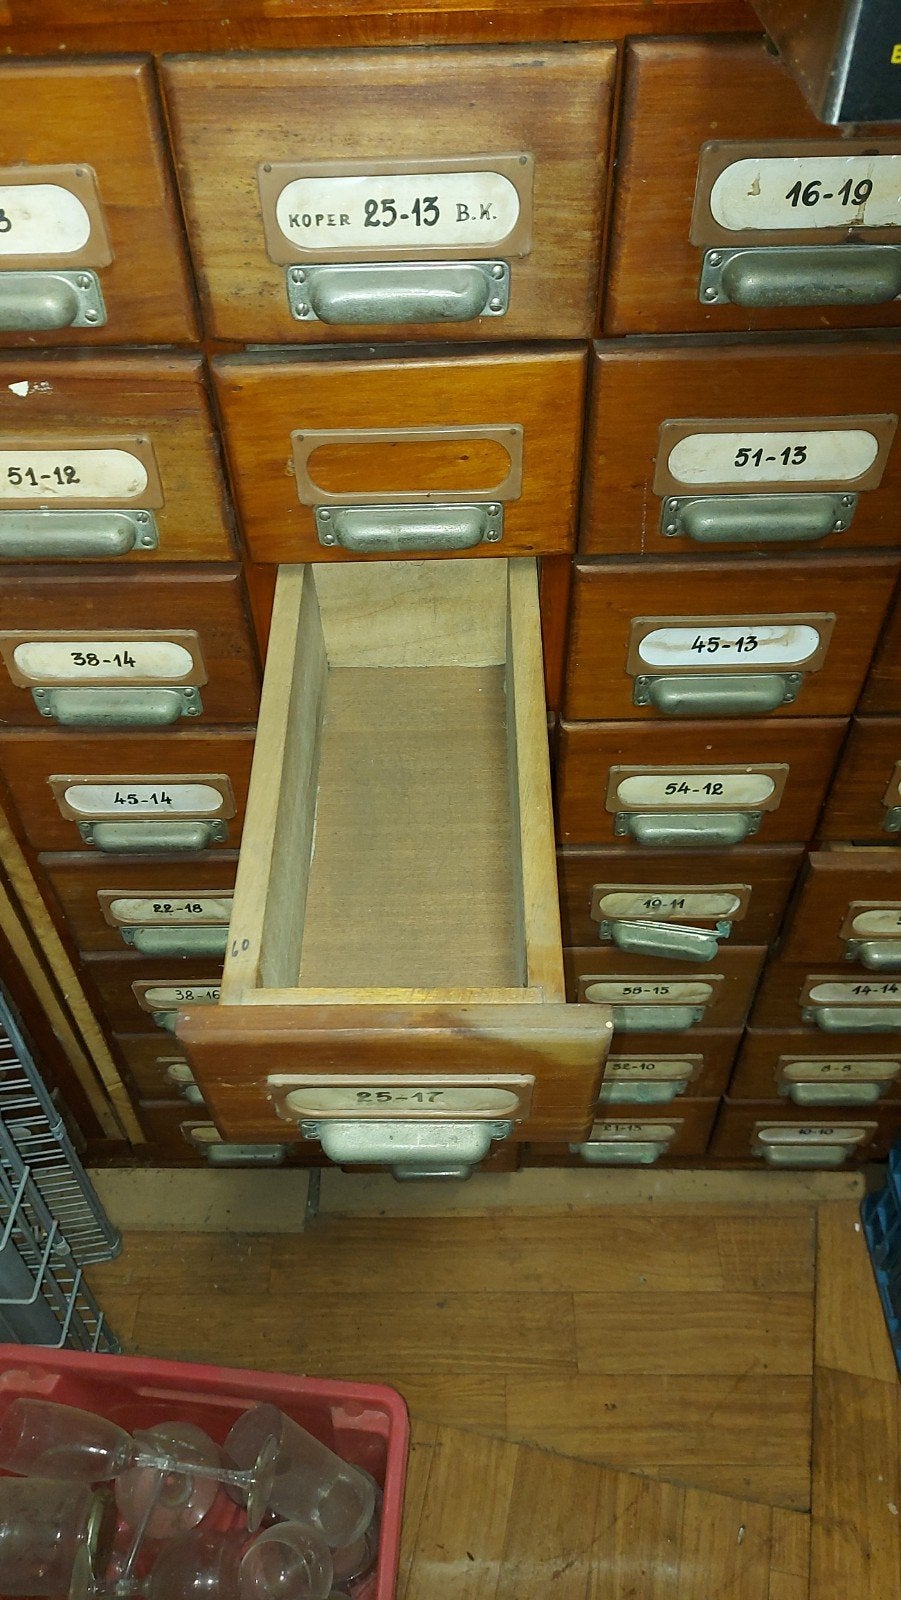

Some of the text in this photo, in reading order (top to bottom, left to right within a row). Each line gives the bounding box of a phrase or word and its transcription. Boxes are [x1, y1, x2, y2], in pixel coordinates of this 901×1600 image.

[784, 178, 874, 207] 16-19
[288, 195, 498, 228] KOPER 25-13 B.K.
[734, 446, 807, 467] 51-13
[7, 465, 82, 487] 51-12
[690, 634, 759, 652] 45-13
[71, 651, 136, 669] 38-14
[664, 781, 724, 797] 54-12
[113, 790, 173, 806] 45-14
[152, 902, 204, 914] 22-18
[174, 989, 220, 1001] 38-16
[851, 984, 898, 995] 14-14
[356, 1091, 444, 1103] 25-17
